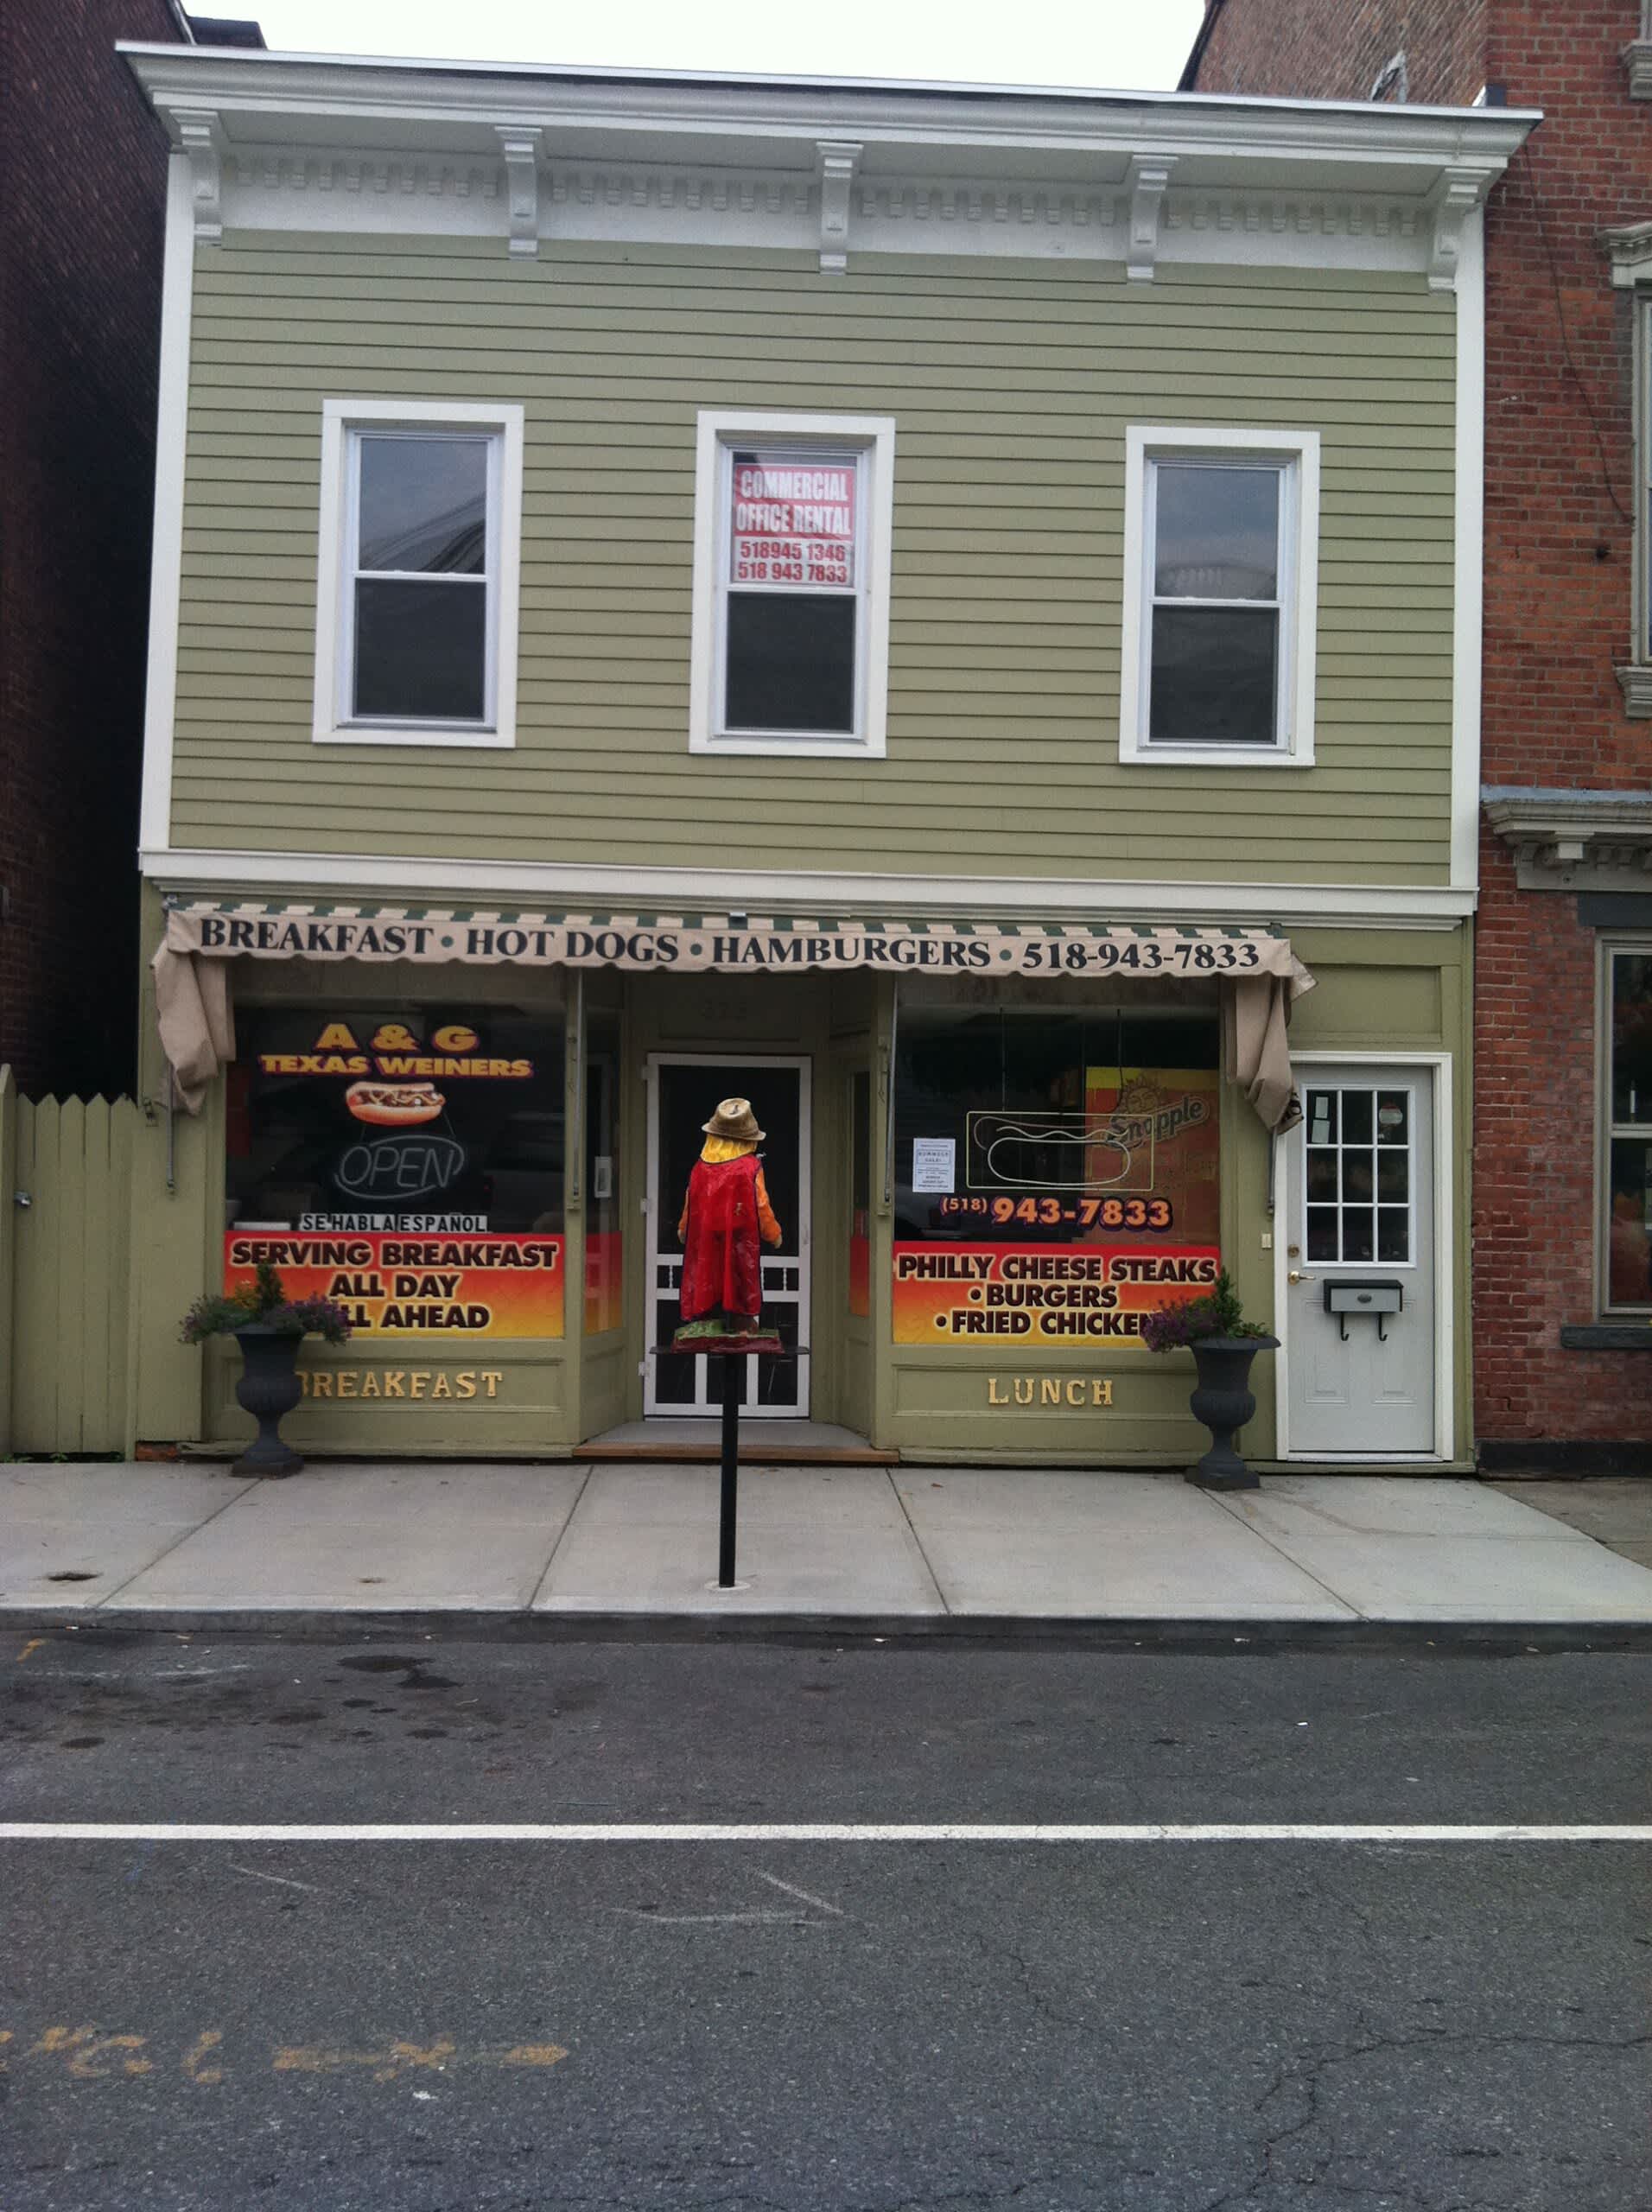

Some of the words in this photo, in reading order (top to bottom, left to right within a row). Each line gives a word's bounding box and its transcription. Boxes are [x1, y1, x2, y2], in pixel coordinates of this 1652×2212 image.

[740, 470, 848, 501] COMMERCIAL
[736, 503, 791, 532] OFFICE
[793, 505, 851, 535] RENTAL
[738, 563, 767, 579] 518
[772, 563, 803, 581] 943
[808, 564, 848, 582] 7833
[200, 918, 435, 955] BREAKFAST
[466, 929, 554, 957] HOT
[566, 931, 678, 963] DOGS
[712, 937, 991, 967] HAMBURGERS
[1022, 942, 1260, 969] 518-943-7833
[314, 1023, 359, 1052] A
[371, 1024, 421, 1052] &
[432, 1025, 480, 1052] G
[259, 1054, 371, 1077] TEXAS
[375, 1056, 533, 1078] WEINERS
[1106, 1096, 1204, 1150] Snapple
[340, 1145, 454, 1188] OPEN
[303, 1215, 328, 1230] SE
[332, 1215, 394, 1230] HABLA
[940, 1196, 988, 1215] (518)
[991, 1197, 1172, 1230] 943-7833
[232, 1240, 372, 1266] SERVING
[381, 1242, 558, 1268] BREAKFAST
[898, 1255, 994, 1279] PHILLY
[1001, 1256, 1101, 1280] CHEESE
[1110, 1258, 1216, 1282] STEAKS
[329, 1273, 384, 1297] ALL
[395, 1274, 460, 1297] DAY
[986, 1284, 1117, 1307] BURGERS
[380, 1305, 490, 1328] AHEAD
[951, 1310, 1031, 1333] FRIED
[988, 1377, 1114, 1406] LUNCH
